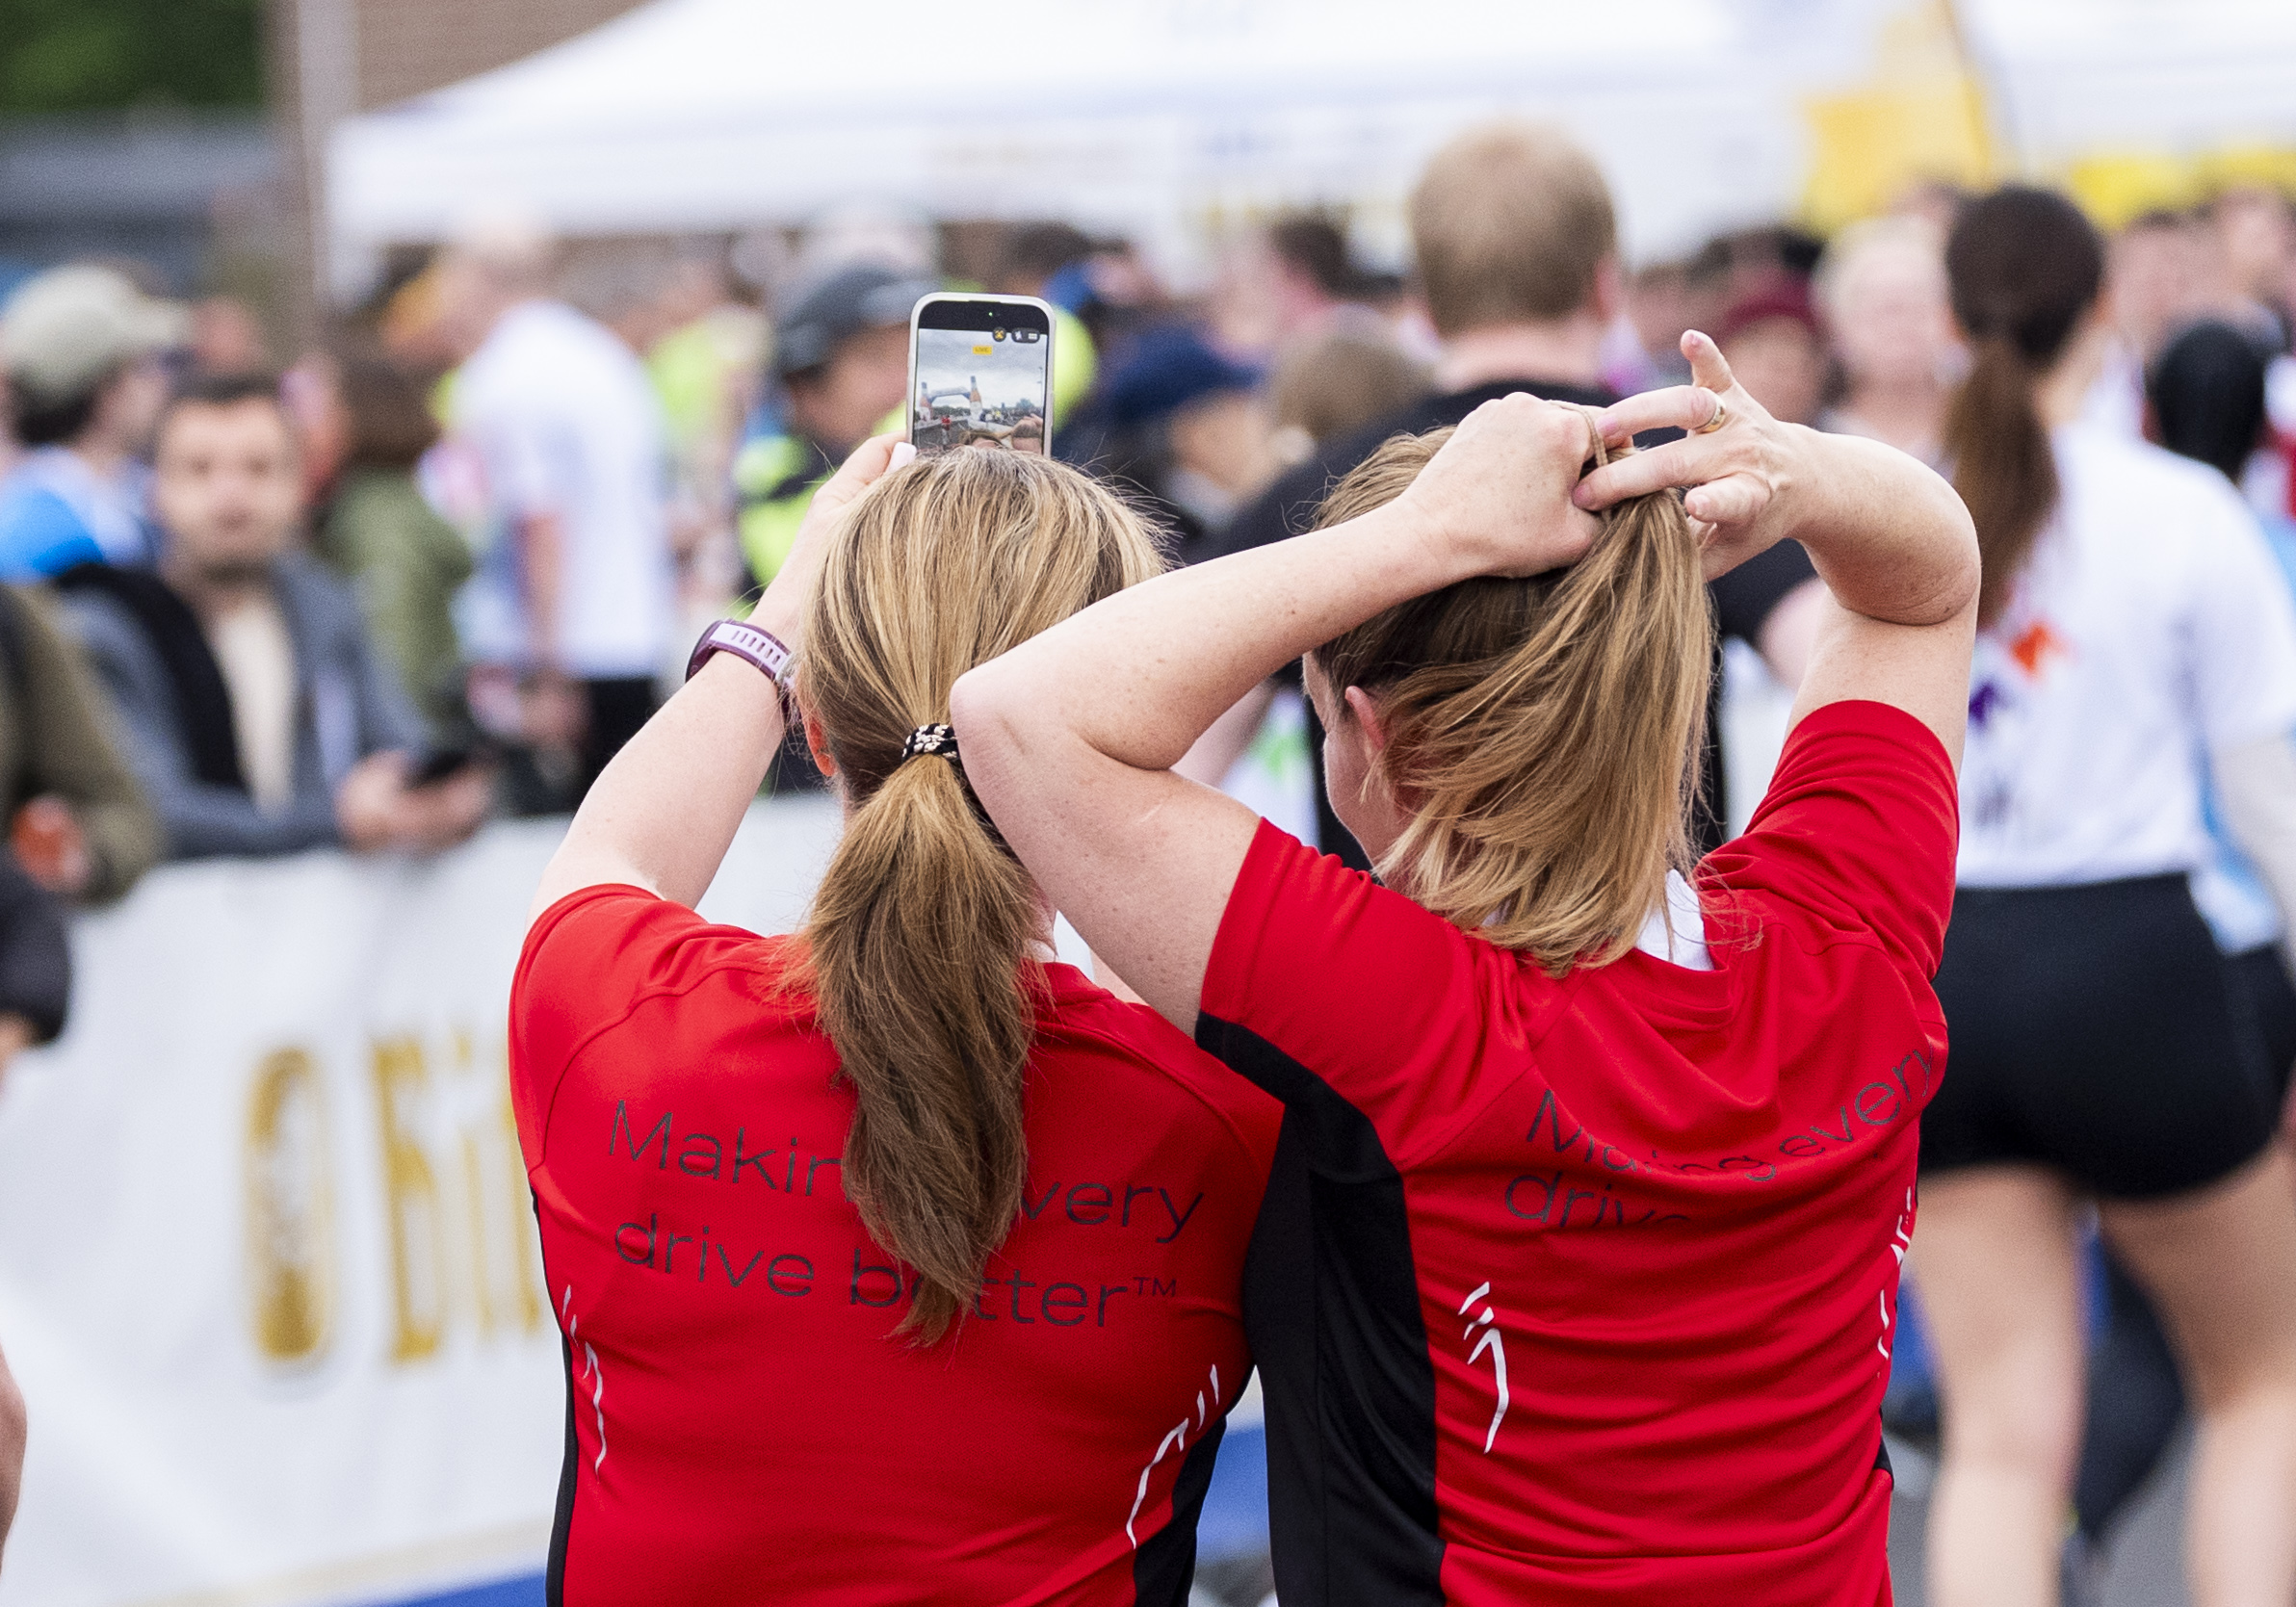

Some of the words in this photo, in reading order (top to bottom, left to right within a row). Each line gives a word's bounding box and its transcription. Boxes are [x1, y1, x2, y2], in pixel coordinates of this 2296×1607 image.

[609, 1100, 852, 1204] Makin
[1021, 1176, 1204, 1243] very
[614, 1213, 815, 1297] drive
[849, 1249, 1177, 1328] btter™
